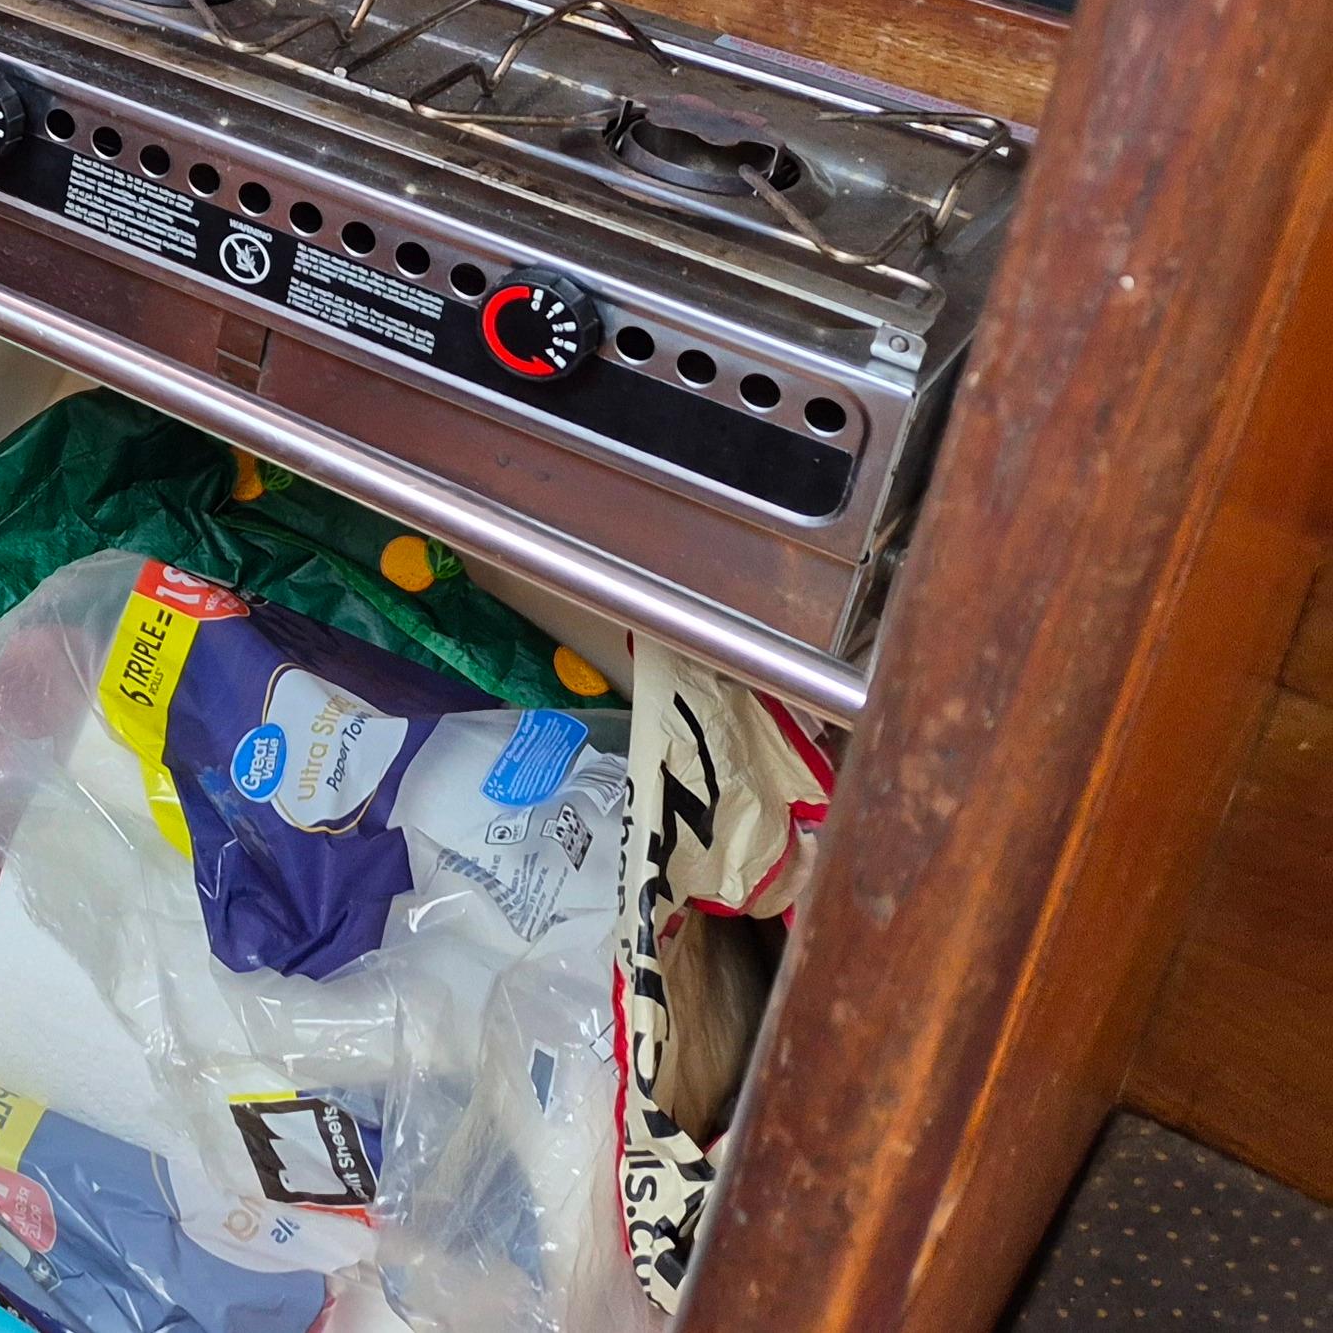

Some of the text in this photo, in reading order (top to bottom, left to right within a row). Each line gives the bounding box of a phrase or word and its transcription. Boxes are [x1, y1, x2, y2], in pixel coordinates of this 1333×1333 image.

[229, 218, 273, 243] WARNING
[123, 621, 166, 688] TRIPLE
[119, 683, 154, 708] 6
[148, 670, 164, 696] ROLLS
[241, 737, 270, 790] Great
[261, 737, 280, 780] Value
[298, 742, 329, 802] Ultra
[326, 741, 350, 793] Paper
[323, 1105, 355, 1170] Sheets
